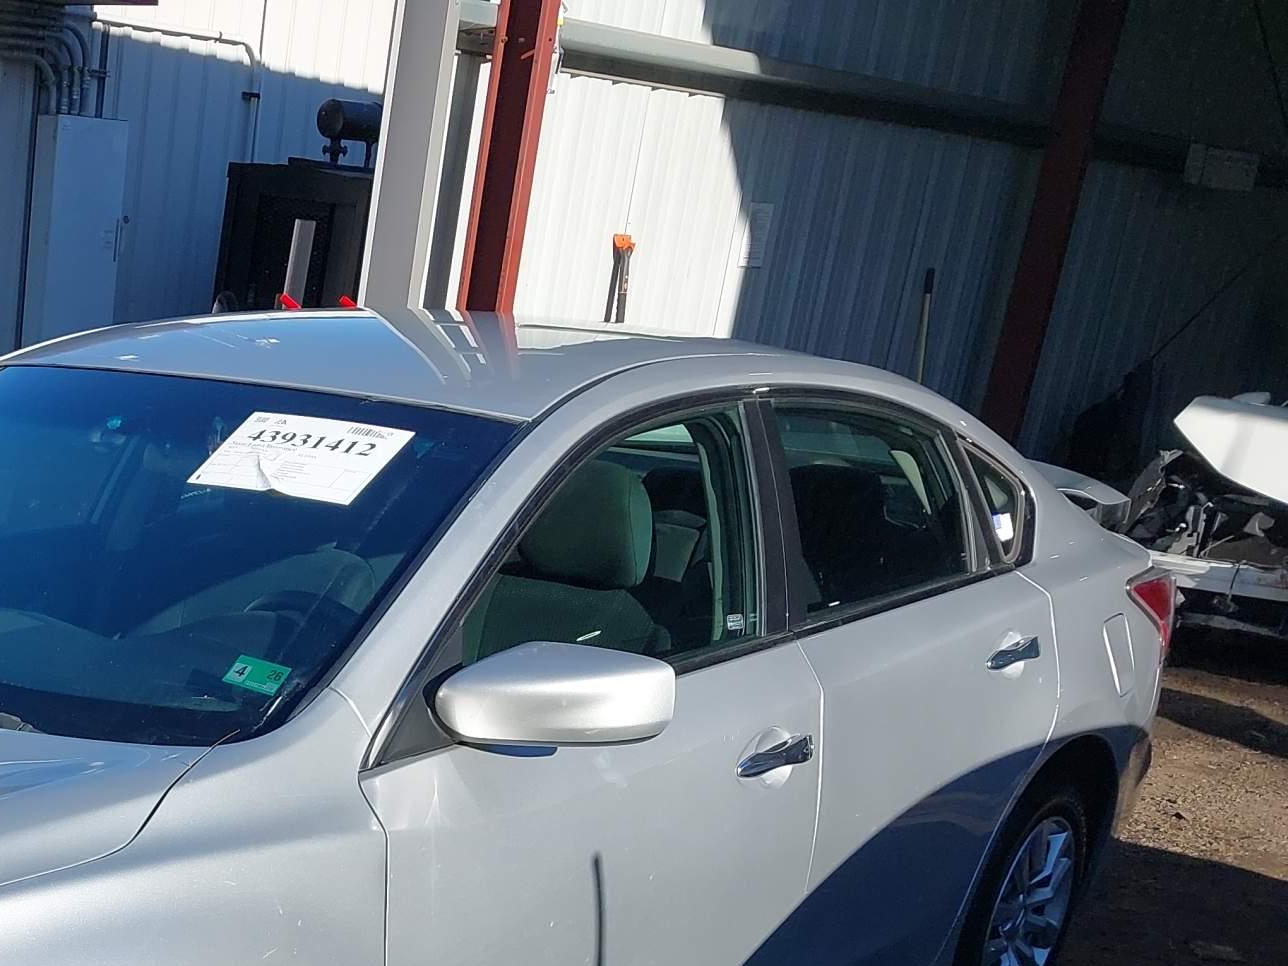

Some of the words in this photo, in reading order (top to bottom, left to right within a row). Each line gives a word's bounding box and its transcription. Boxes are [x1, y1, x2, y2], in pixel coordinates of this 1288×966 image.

[247, 429, 377, 456] 43931412
[234, 665, 249, 677] 4
[266, 669, 284, 681] 26
